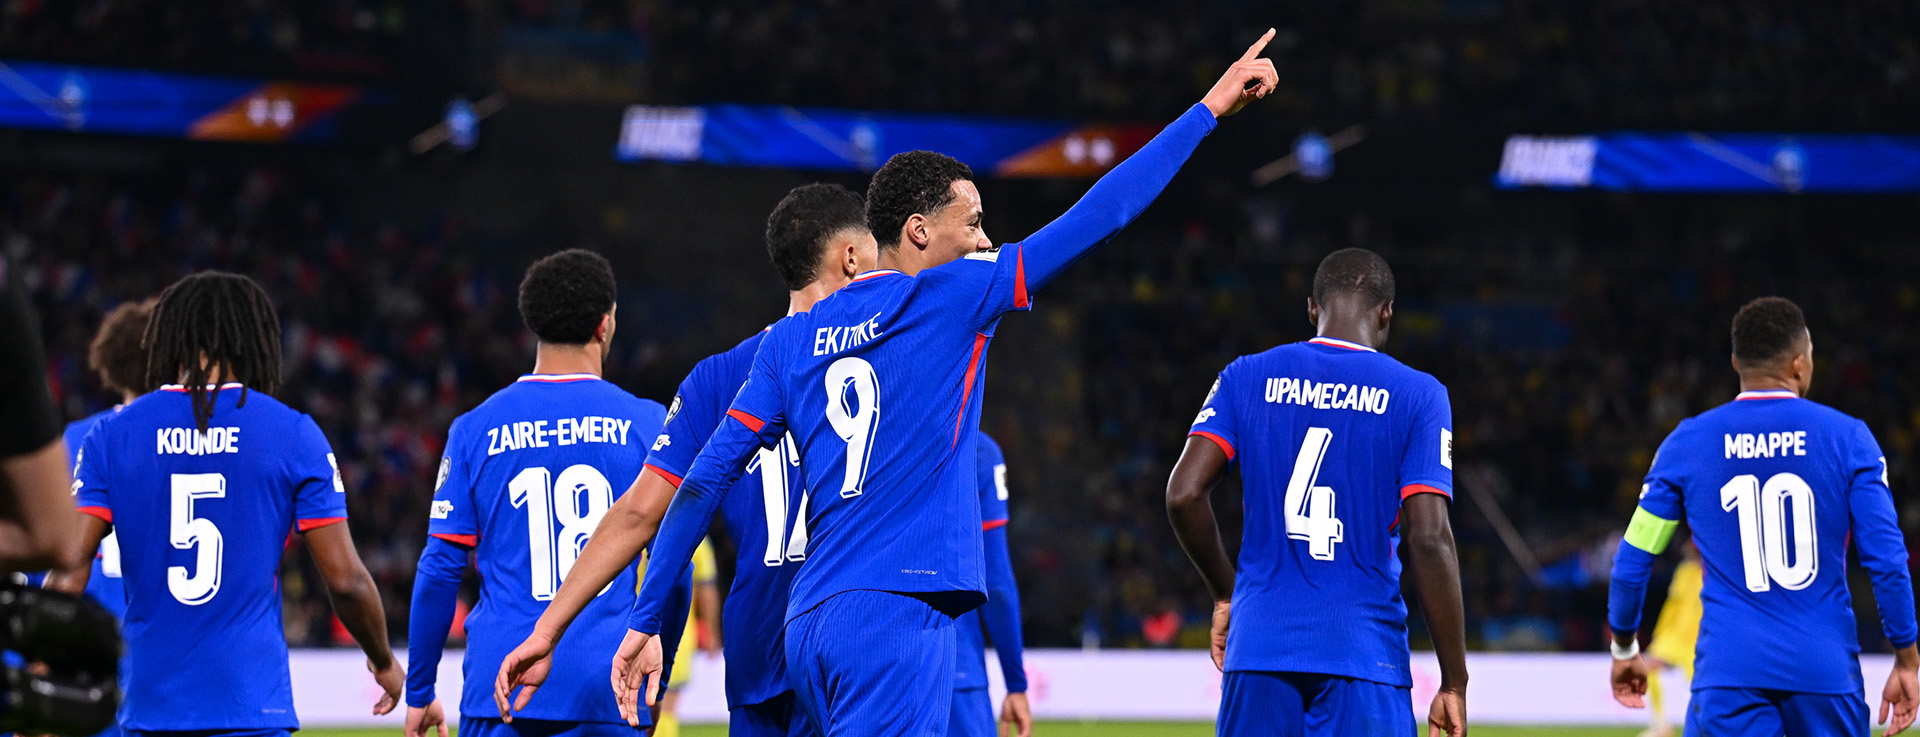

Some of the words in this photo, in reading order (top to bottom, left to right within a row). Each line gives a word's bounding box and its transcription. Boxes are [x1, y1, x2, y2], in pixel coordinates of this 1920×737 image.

[813, 311, 884, 357] EKITIKE
[487, 416, 632, 456] ZAIRE-EMERY
[825, 356, 881, 498] 9
[1264, 377, 1390, 415] UPAMECANO
[156, 426, 240, 456] KOUNDE
[1724, 431, 1807, 459] MBAPPE
[508, 463, 614, 602] 18
[1283, 427, 1344, 561] 4
[1720, 472, 1819, 592] 10
[167, 473, 226, 606] 5
